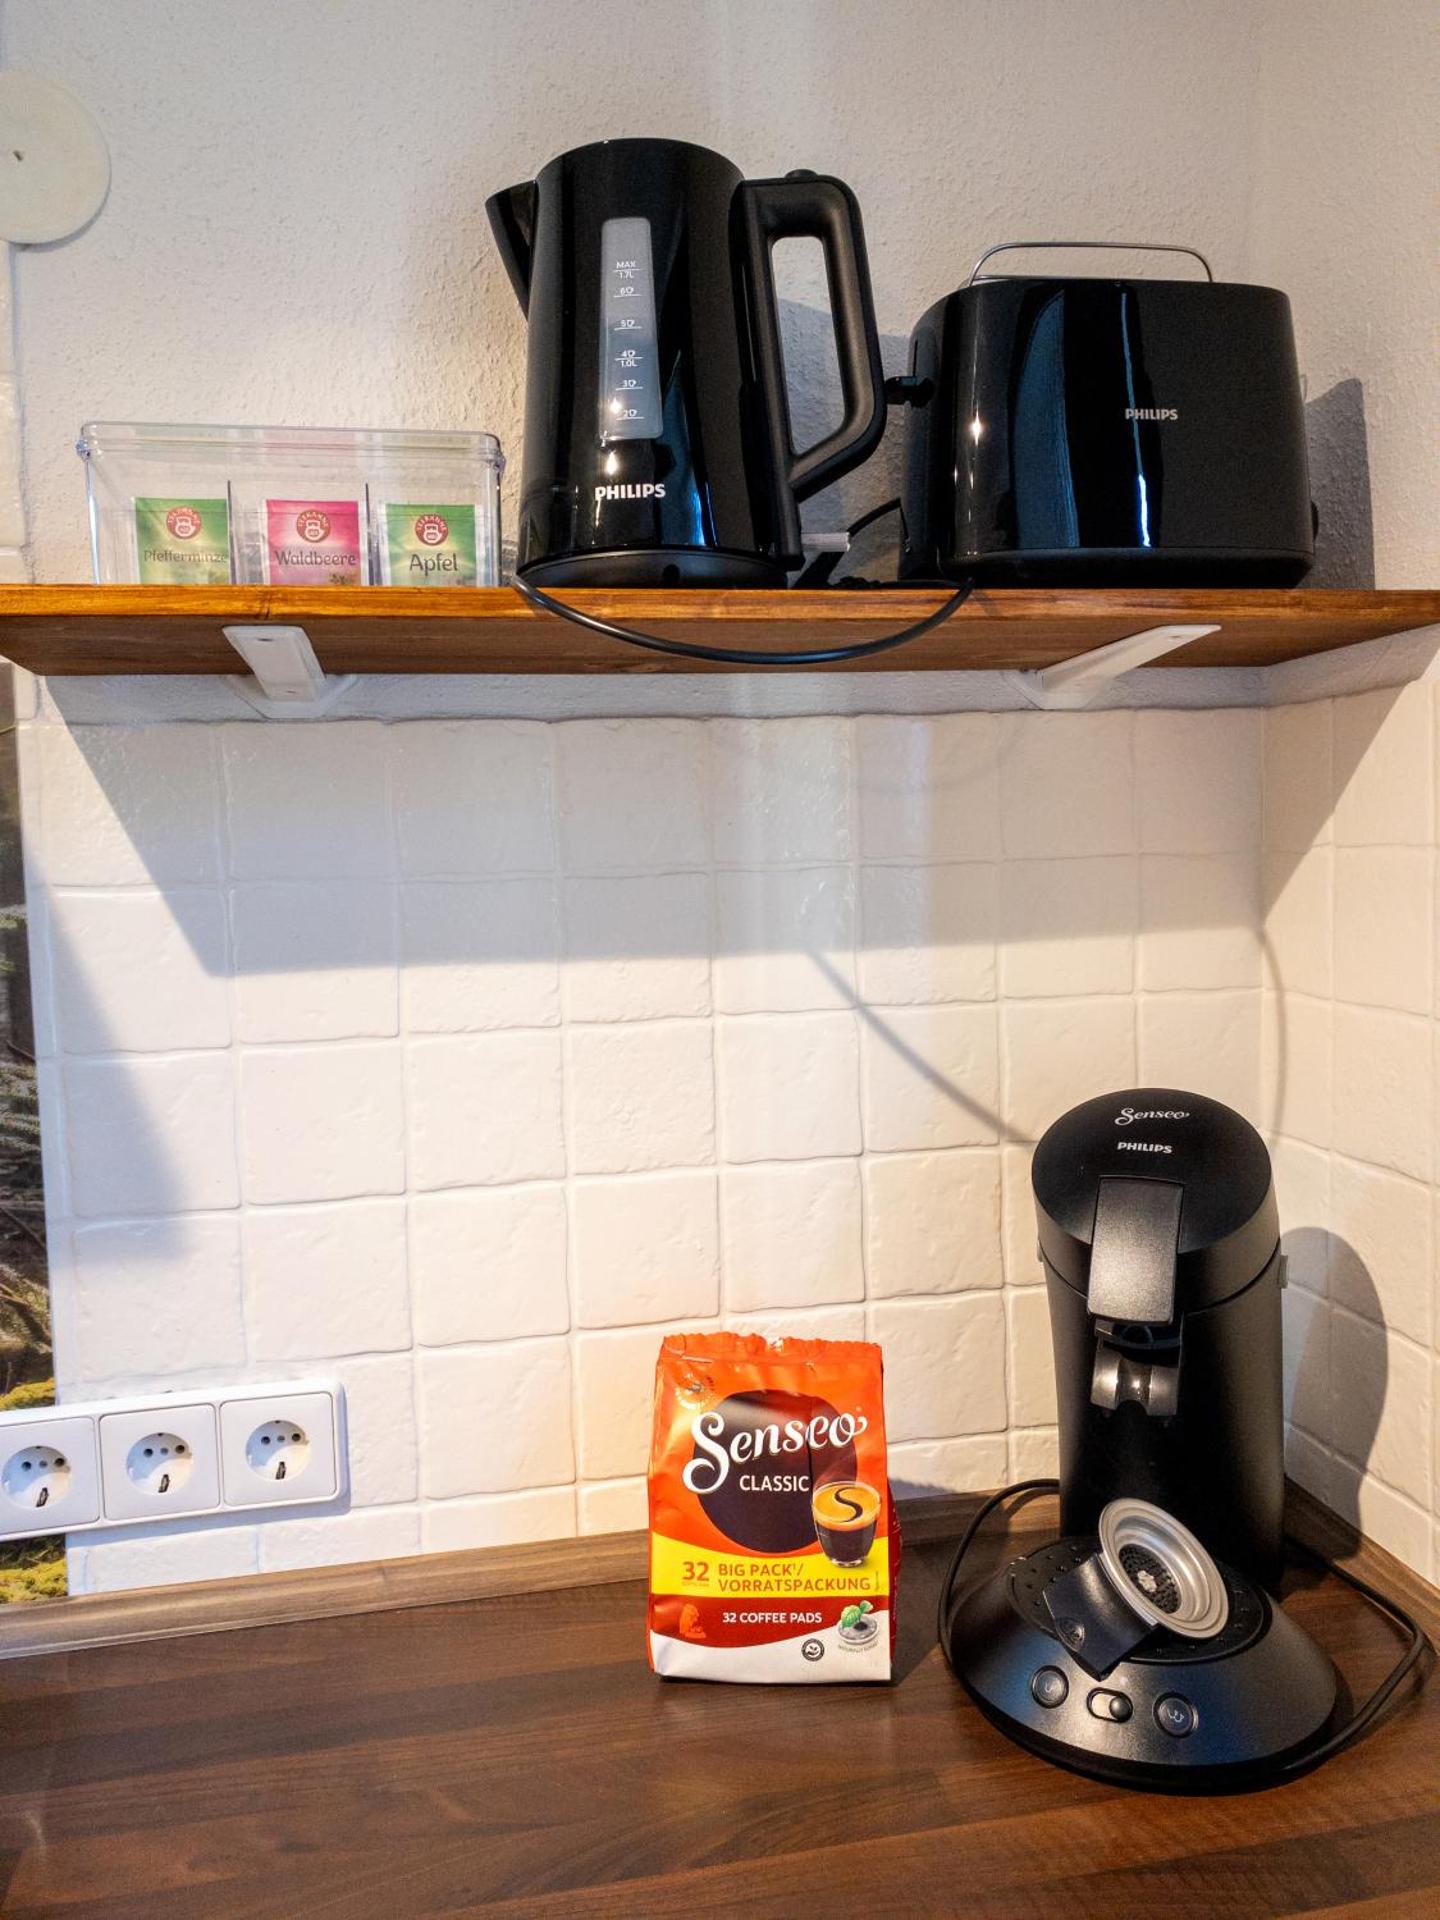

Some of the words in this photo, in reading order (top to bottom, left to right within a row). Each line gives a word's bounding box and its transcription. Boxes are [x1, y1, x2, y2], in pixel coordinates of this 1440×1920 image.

[616, 260, 636, 269] MAX
[1125, 408, 1178, 420] PHILIPS
[594, 483, 666, 500] PHILIPS
[274, 550, 356, 566] Waldbeere
[409, 552, 458, 576] Apfel
[1114, 1107, 1190, 1126] Senseo
[1117, 1142, 1173, 1154] PHILIPS
[682, 1411, 868, 1494] Senseo
[739, 1475, 810, 1492] CLASSIC
[682, 1561, 710, 1582] 32
[718, 1563, 745, 1577] BIG
[718, 1577, 871, 1592] VORRATSPACKUNG
[722, 1612, 737, 1623] 32
[739, 1612, 787, 1623] COFFEE
[790, 1612, 823, 1623] PADS
